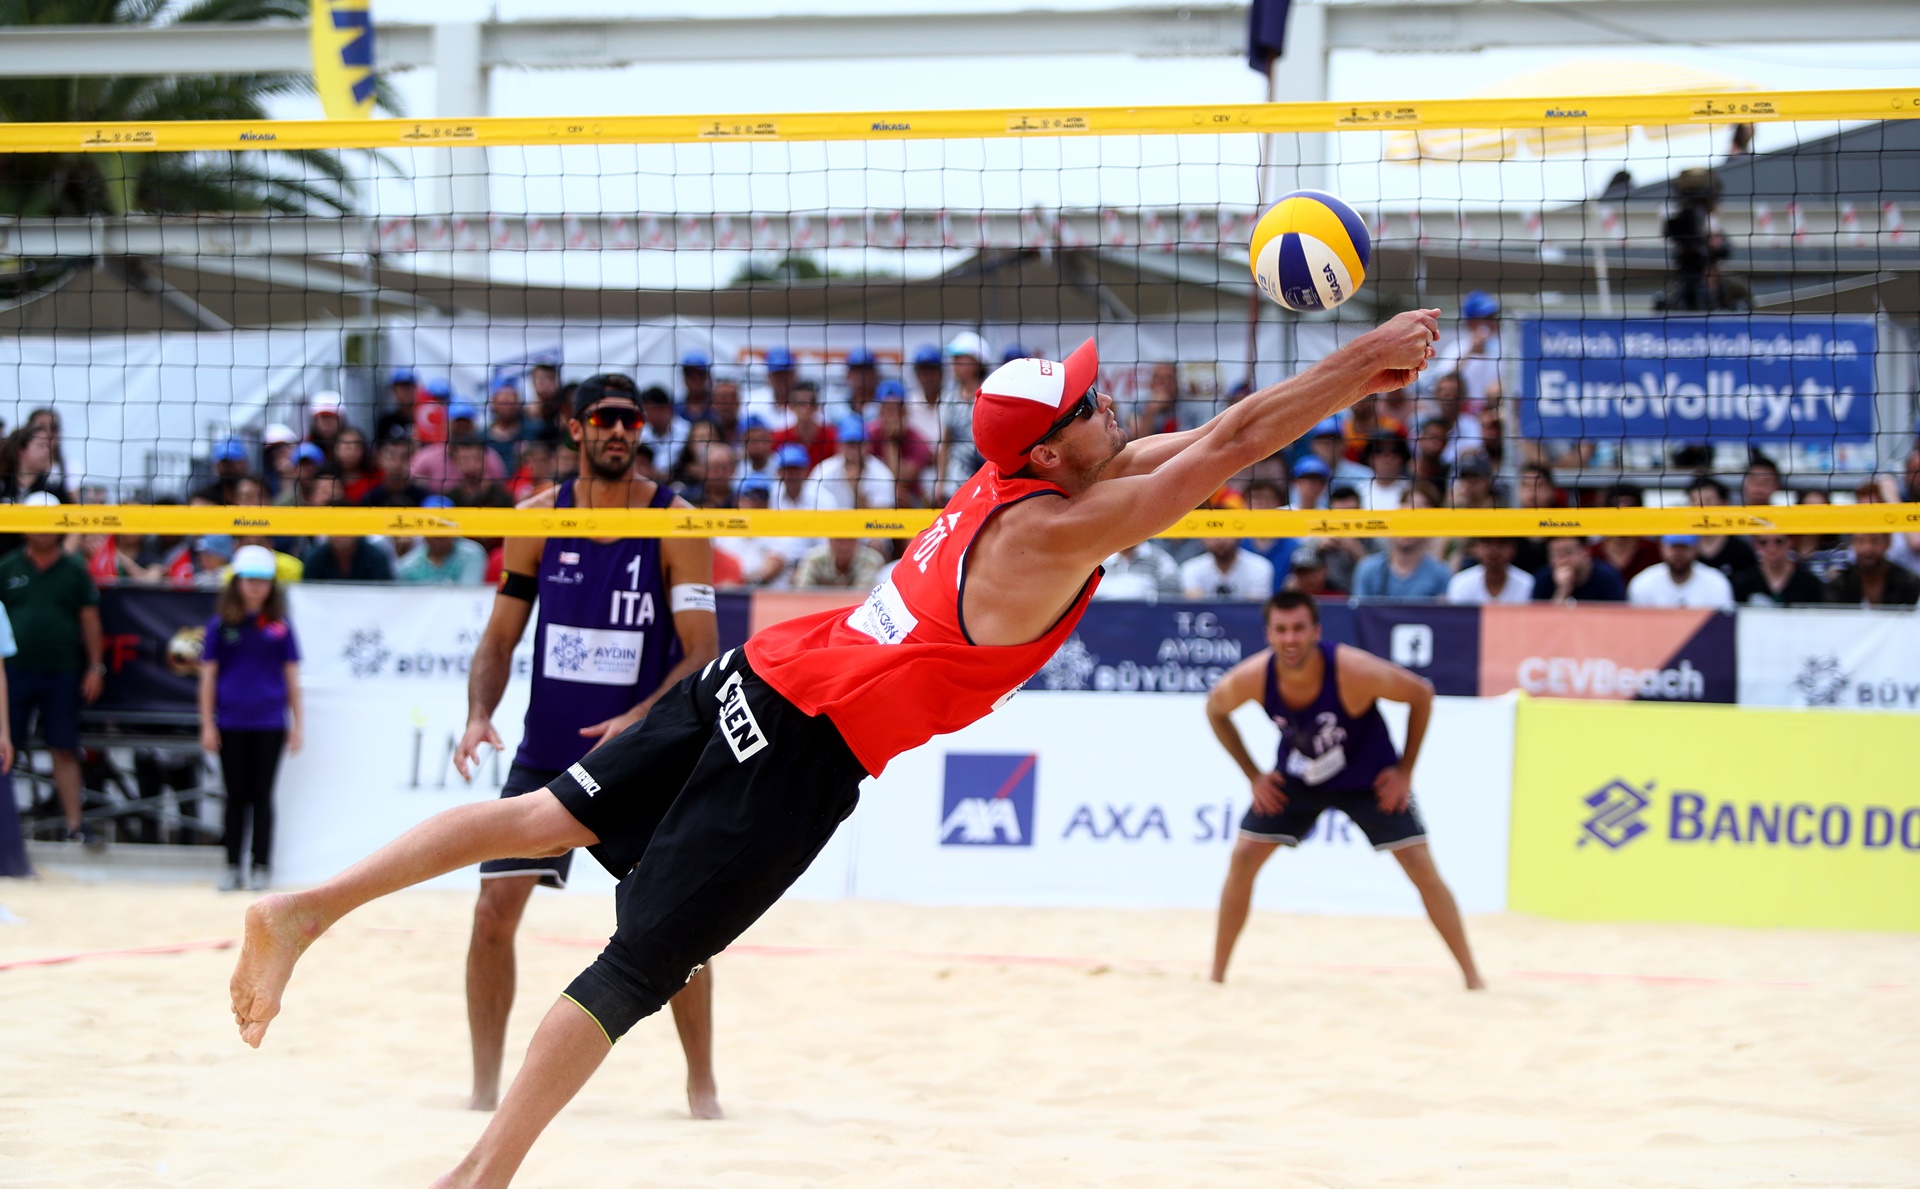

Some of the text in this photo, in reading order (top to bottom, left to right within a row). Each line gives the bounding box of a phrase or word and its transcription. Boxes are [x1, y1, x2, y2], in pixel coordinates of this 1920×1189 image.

[567, 125, 584, 134] CEV
[1212, 115, 1231, 123] CEV
[1538, 370, 1854, 431] EuroVolley.tv
[560, 520, 578, 528] CEV
[1206, 520, 1224, 528] CEV
[1905, 514, 1920, 522] CE
[626, 554, 642, 591] 1
[610, 590, 655, 626] ITA
[594, 646, 637, 660] AYDIN
[1157, 637, 1242, 664] AYDIN
[1517, 656, 1705, 700] CEVBeach
[939, 796, 1024, 845] AXA
[1062, 804, 1172, 842] AXA
[1668, 792, 1920, 851] BANCO DO
